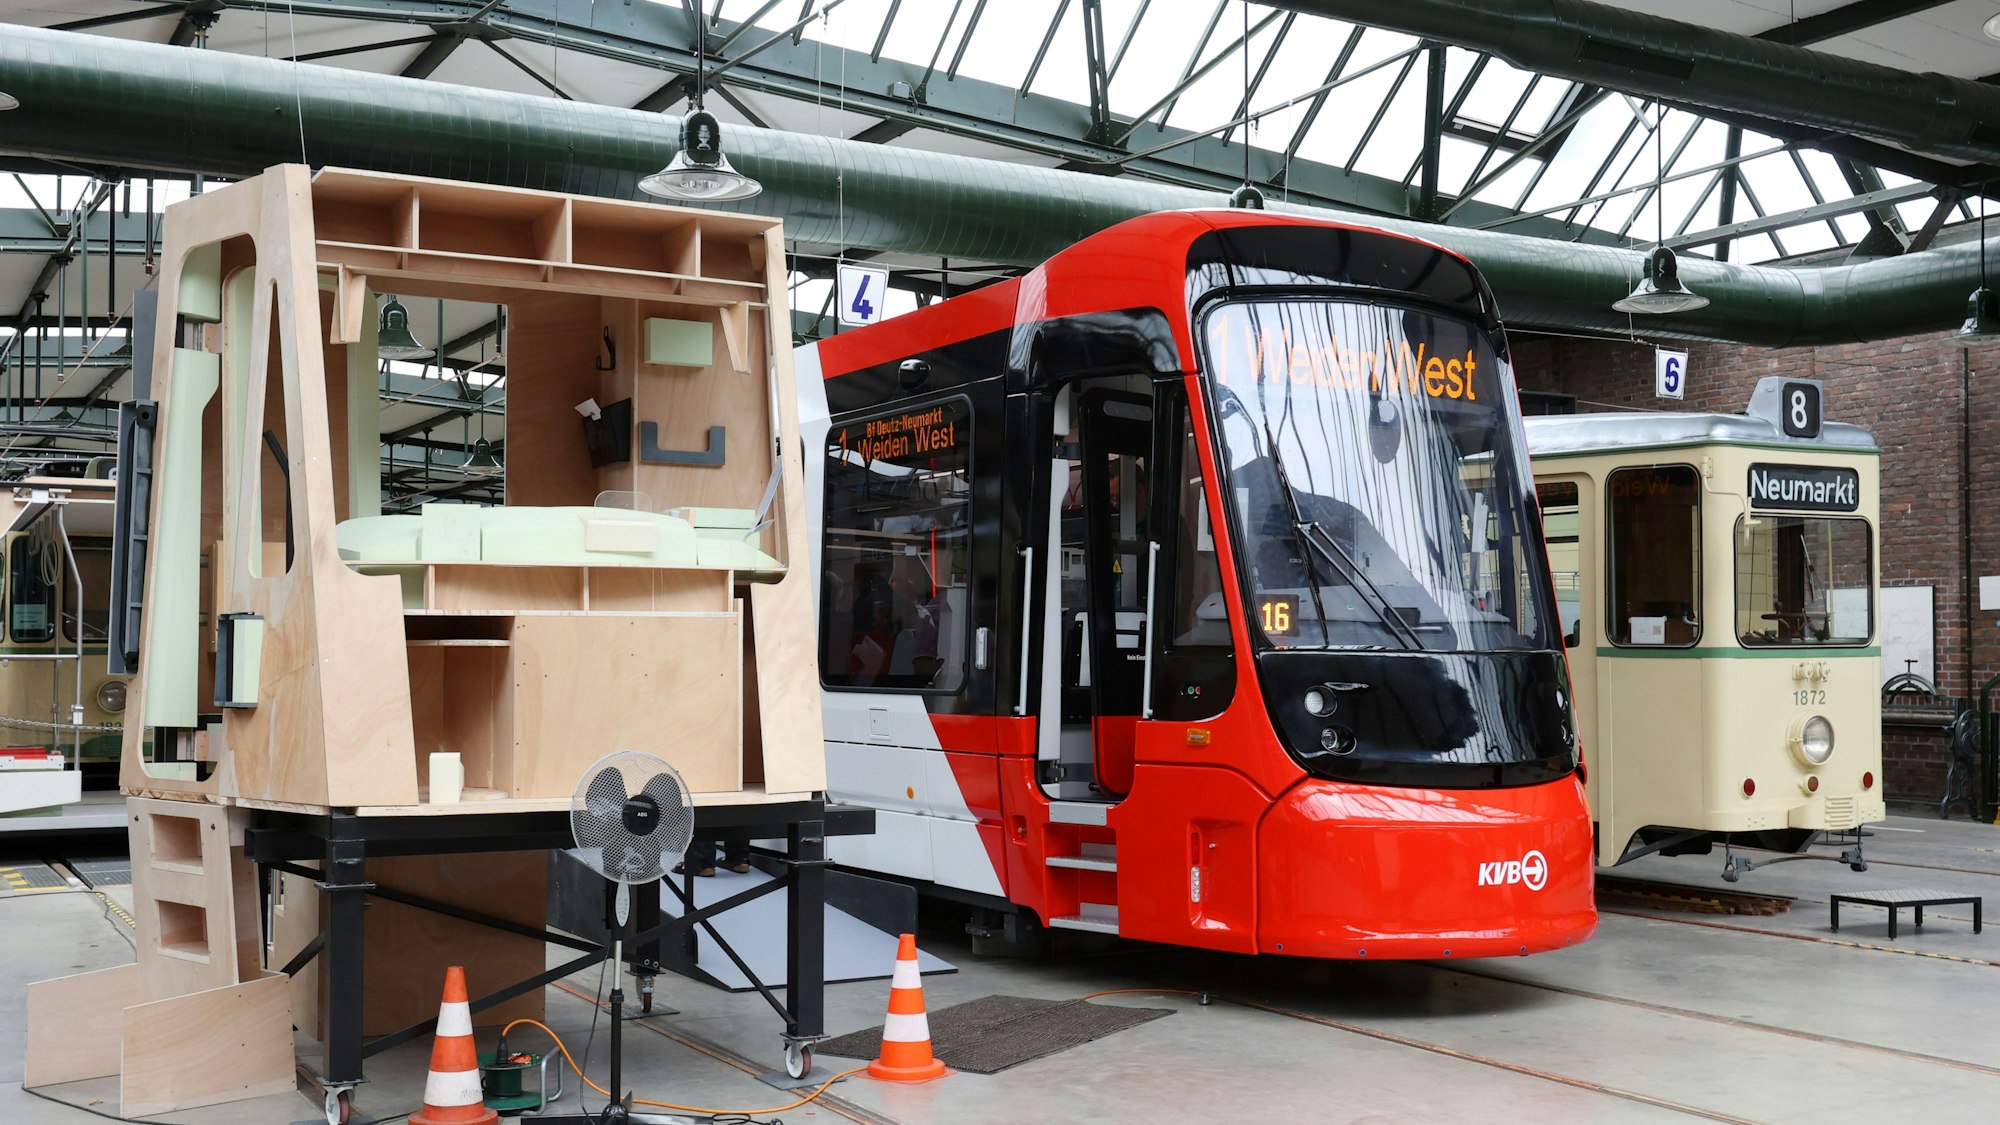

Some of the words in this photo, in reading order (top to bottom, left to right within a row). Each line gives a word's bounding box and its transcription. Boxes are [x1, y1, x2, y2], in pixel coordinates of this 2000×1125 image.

[852, 274, 873, 320] 4
[1211, 314, 1230, 386] 1
[1244, 322, 1377, 392] Weiden
[1384, 339, 1476, 400] West
[1665, 357, 1680, 393] 6
[866, 421, 876, 439] Bf
[878, 406, 943, 435] Deutz-Neumarkt
[1791, 389, 1808, 429] 8
[838, 427, 848, 467] 1
[858, 434, 909, 463] Weiden
[914, 420, 955, 454] West
[1751, 469, 1855, 505] Neumarkt
[1262, 602, 1290, 631] 16
[1793, 690, 1826, 706] 1872
[1477, 860, 1522, 887] KVB
